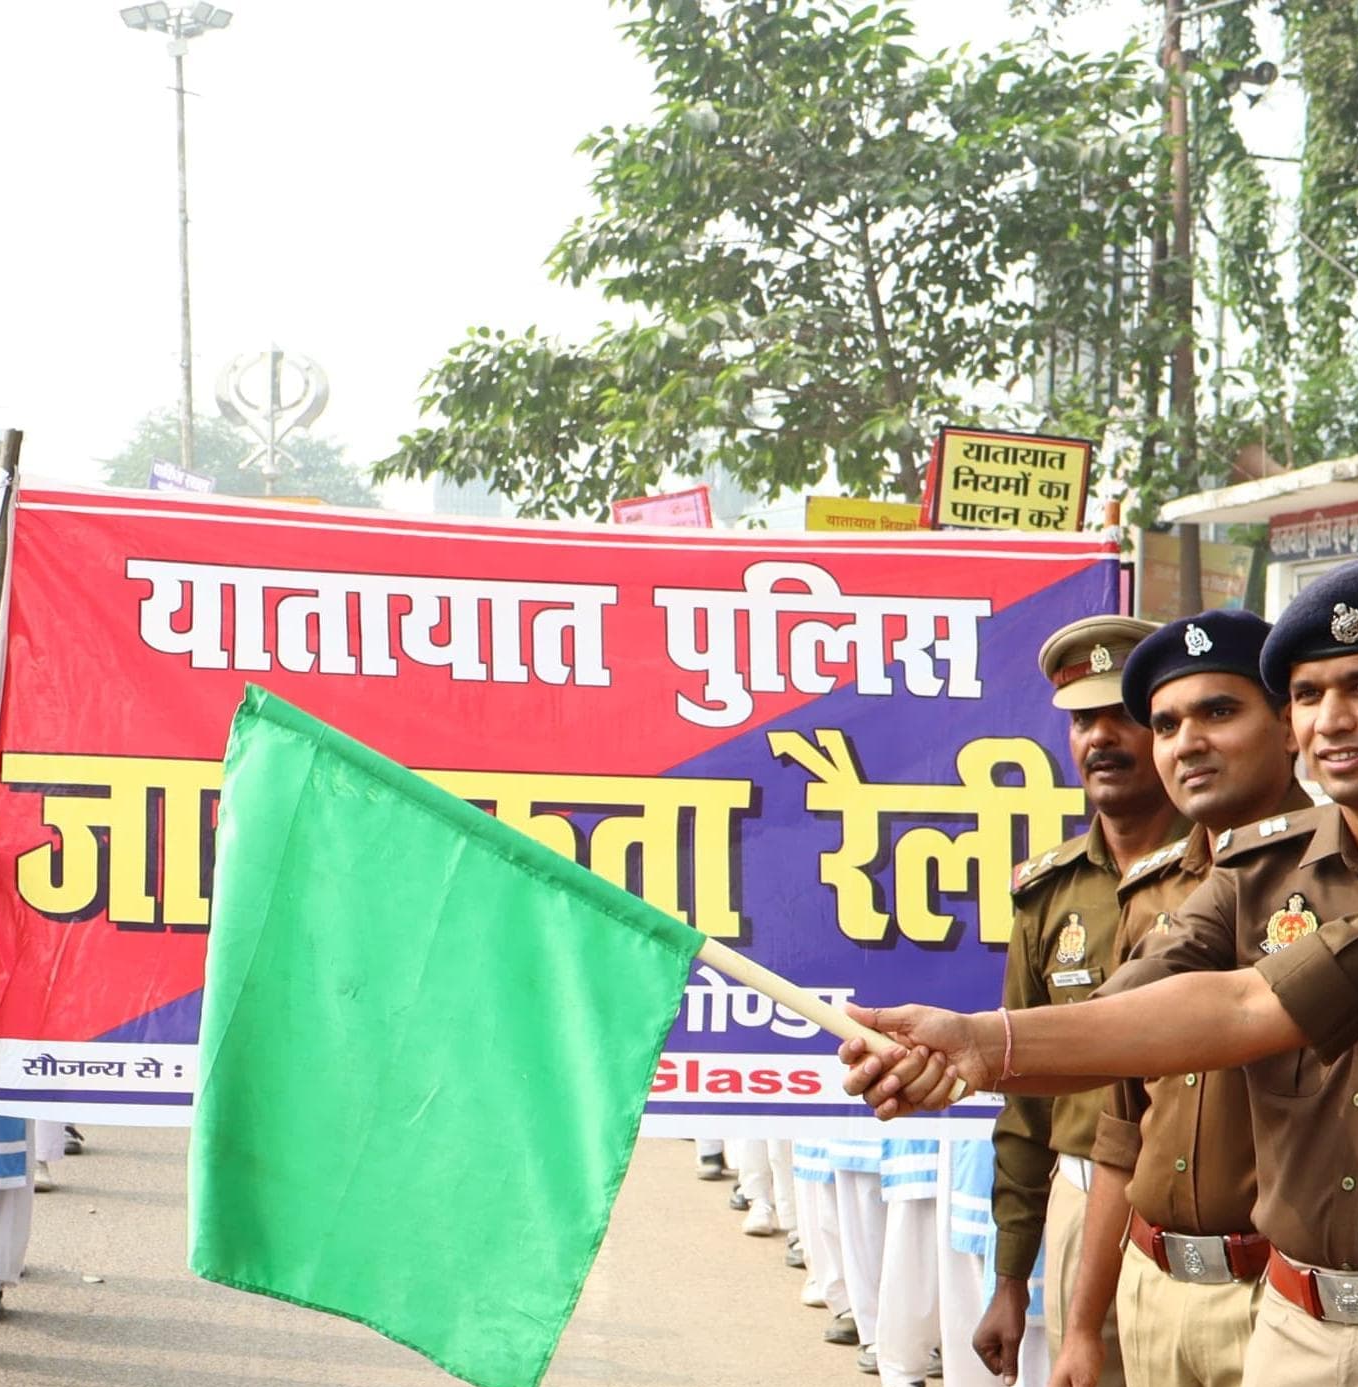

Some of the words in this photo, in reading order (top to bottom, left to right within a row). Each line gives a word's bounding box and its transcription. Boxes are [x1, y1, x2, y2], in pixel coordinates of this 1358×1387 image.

[963, 440, 1065, 470] यातायात
[952, 465, 1032, 499] नियमों
[1038, 480, 1071, 502] का
[951, 501, 1021, 527] पालन
[1028, 506, 1068, 530] करें
[126, 558, 618, 688] यातायात
[653, 560, 993, 727] पुलिस
[767, 728, 1086, 945] रैली
[22, 1053, 124, 1079] सौजन्य
[135, 1056, 165, 1079] से
[649, 1058, 823, 1096] Glass
